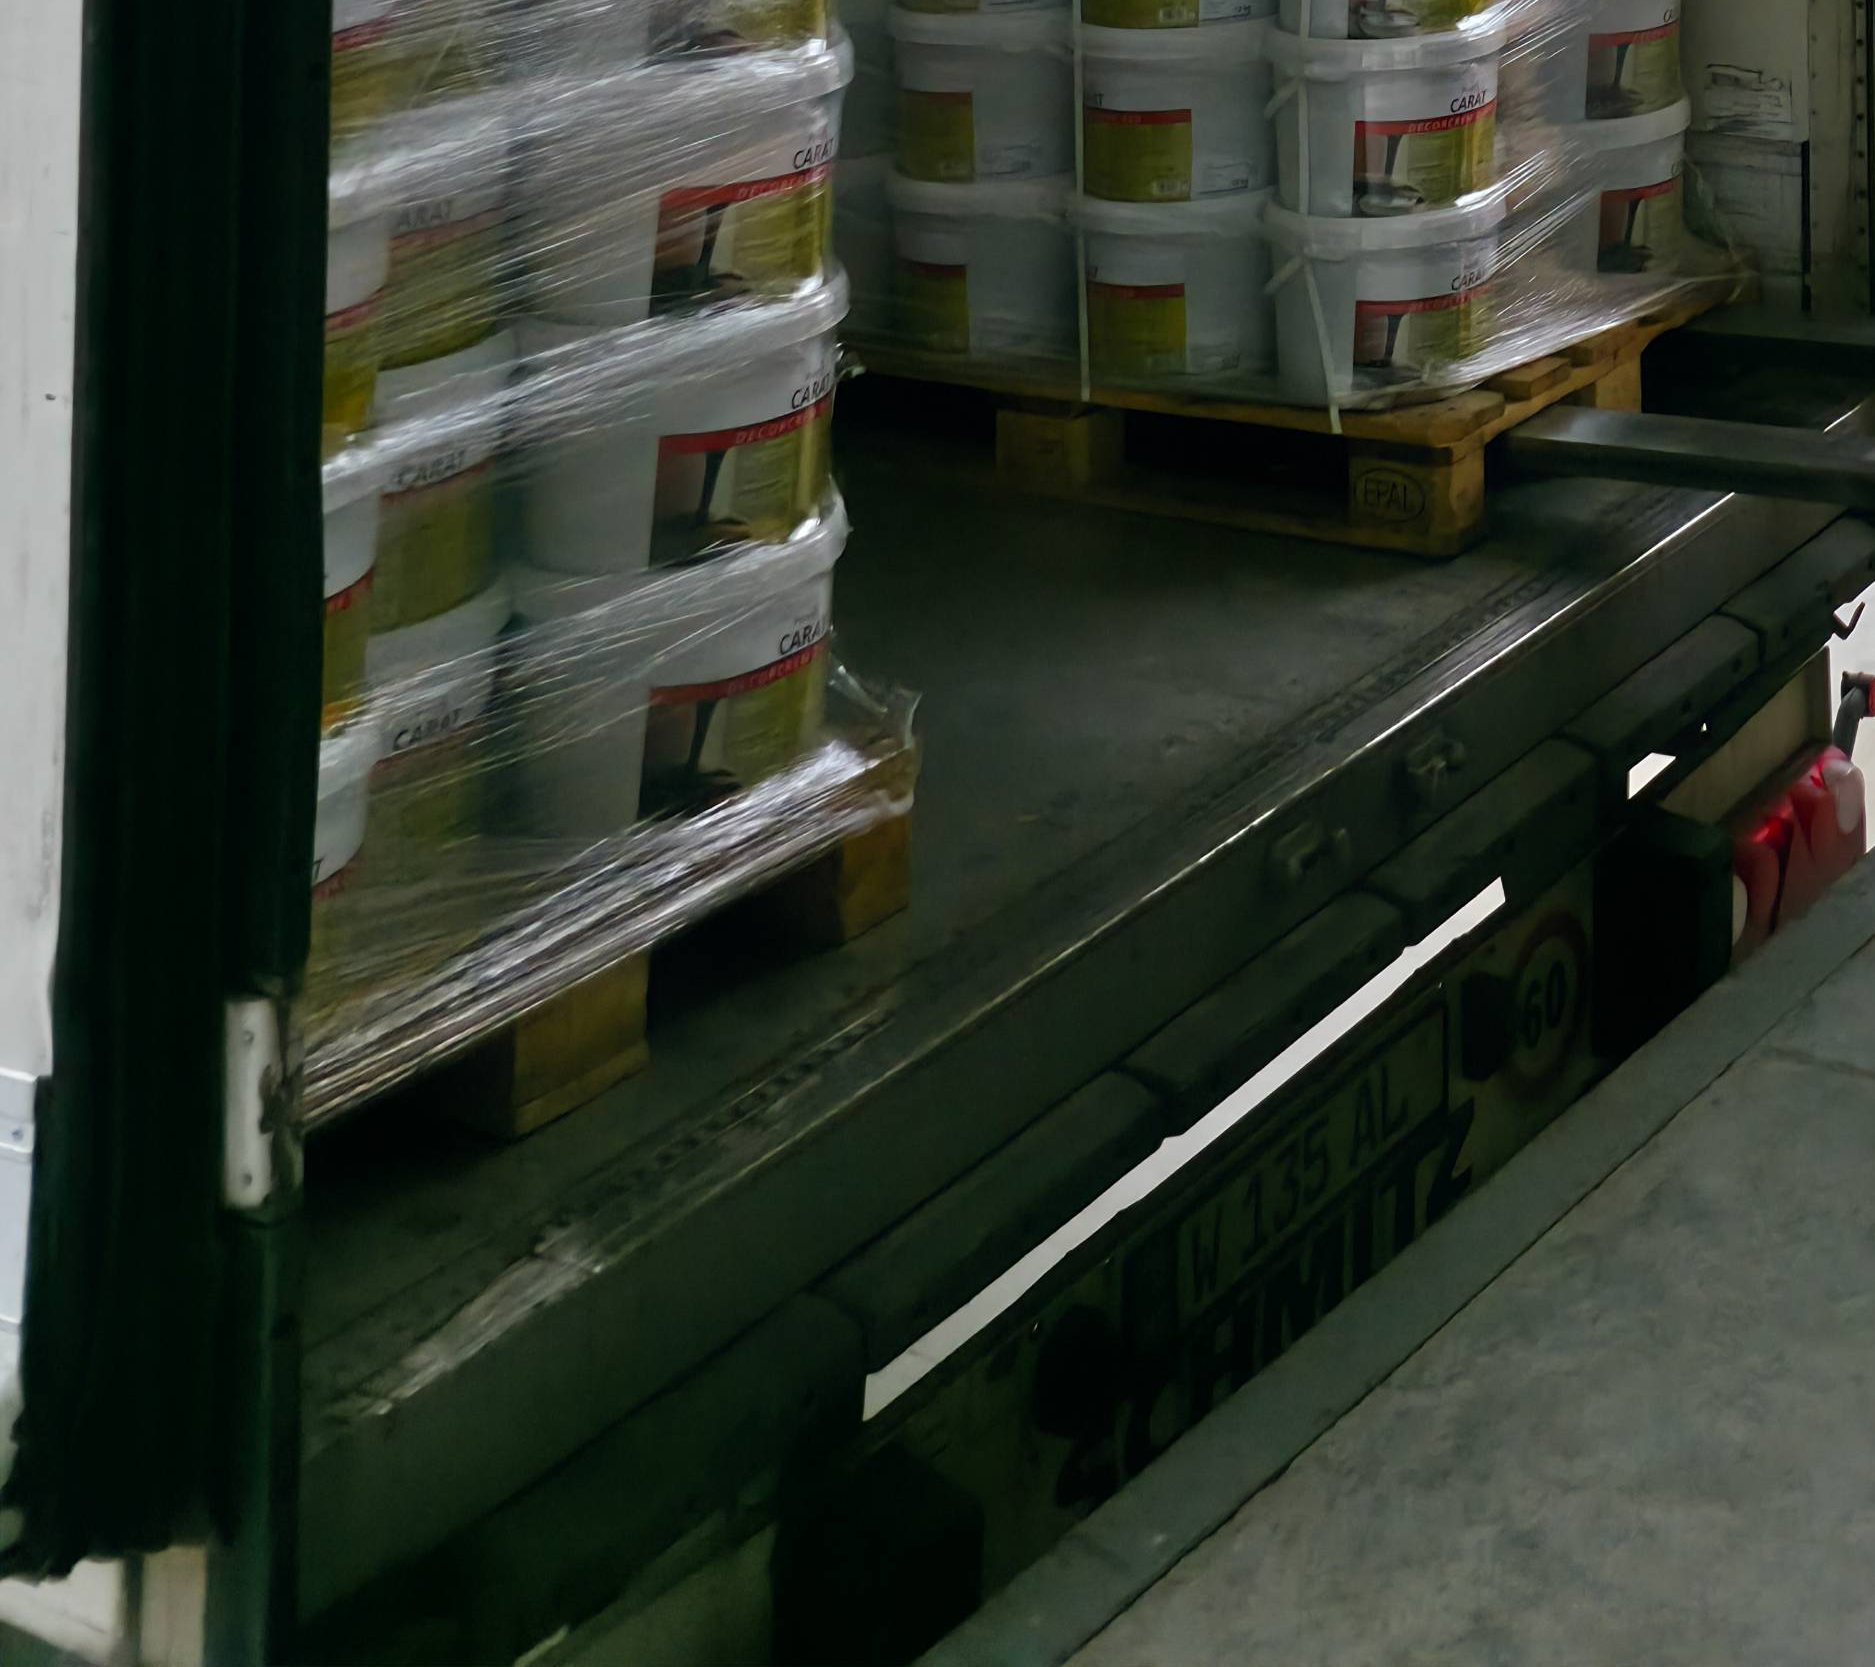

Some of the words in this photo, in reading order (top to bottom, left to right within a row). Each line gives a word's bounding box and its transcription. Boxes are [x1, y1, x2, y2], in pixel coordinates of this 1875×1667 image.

[1450, 90, 1487, 113] CARAT
[1524, 960, 1566, 1049] 60
[1242, 1112, 1329, 1265] 135
[1349, 1064, 1409, 1170] AL
